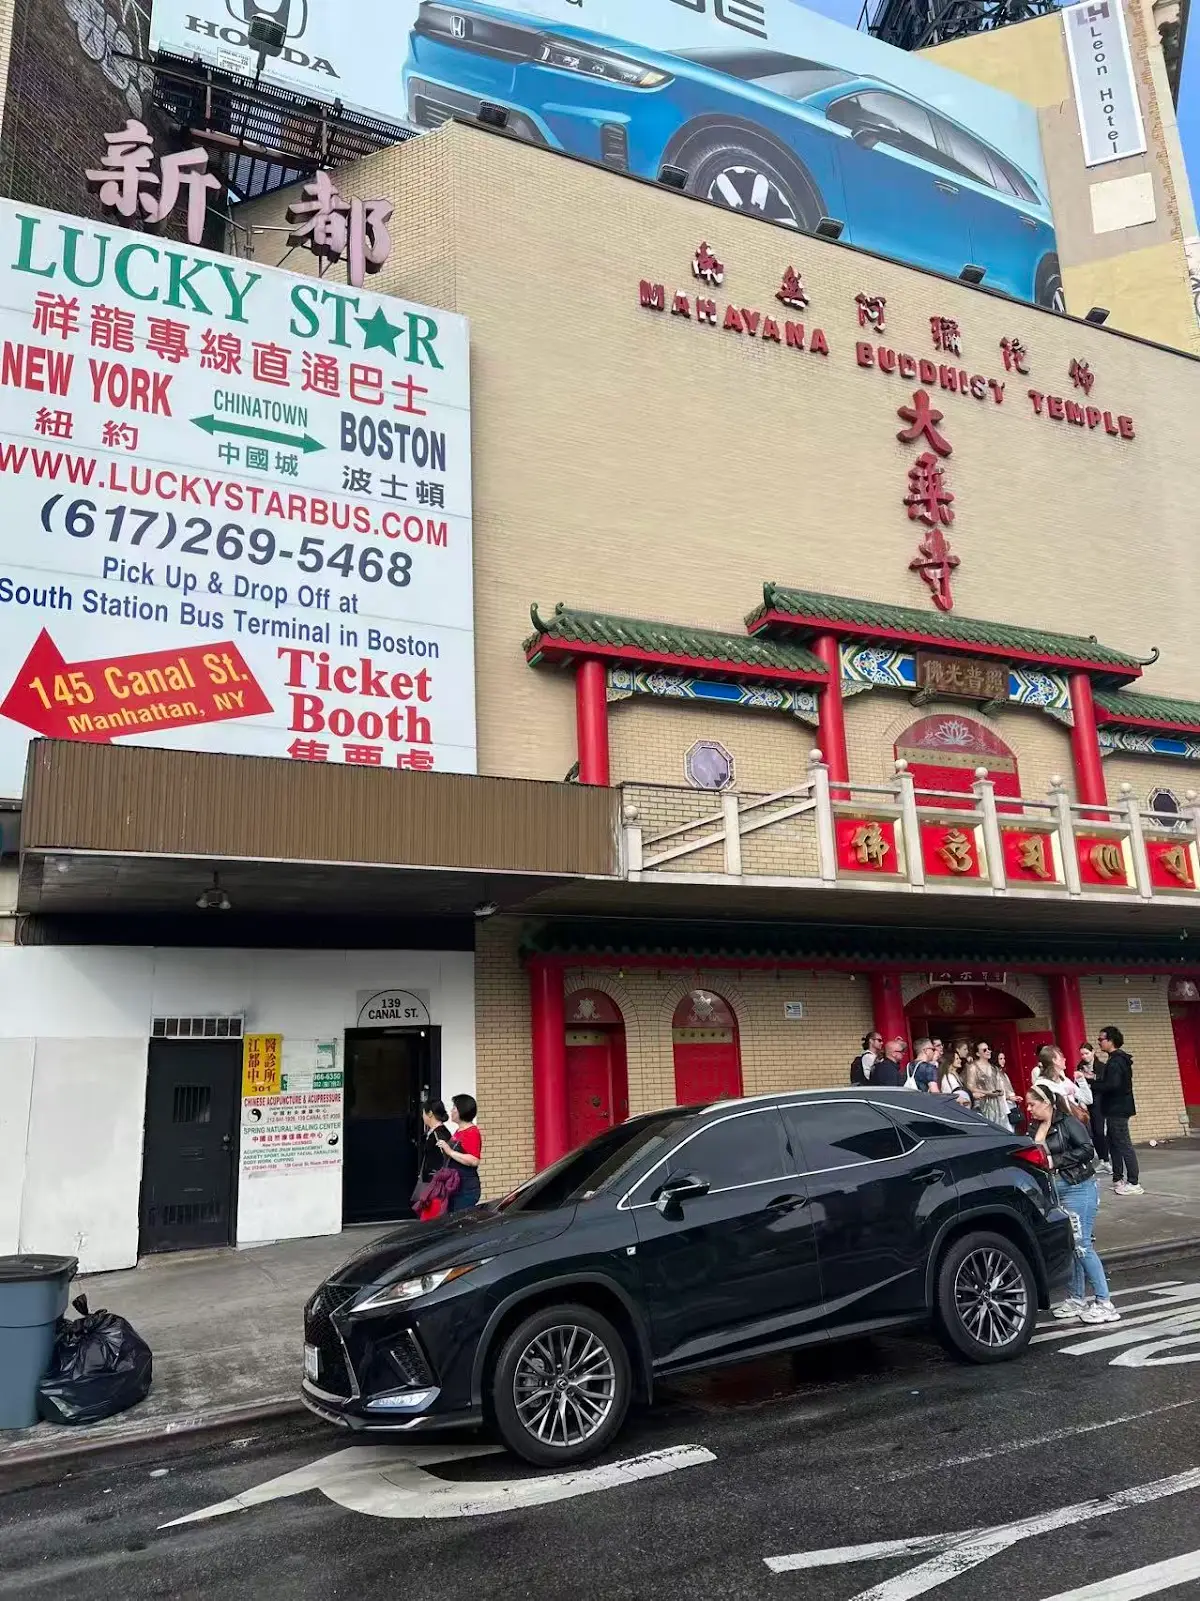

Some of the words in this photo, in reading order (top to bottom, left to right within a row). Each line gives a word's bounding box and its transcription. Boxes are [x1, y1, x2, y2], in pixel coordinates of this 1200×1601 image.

[184, 14, 341, 79] HODA
[1090, 26, 1108, 76] Leon
[1100, 88, 1119, 153] Hotel
[86, 119, 392, 286] 新都
[11, 213, 262, 324] LUCKY
[2, 341, 74, 397] NEW
[89, 358, 173, 417] YORK
[32, 291, 429, 416] 祥龍專線直通巴士
[640, 279, 829, 356] MAHAYANA
[856, 341, 1005, 403] BUDDHIST
[1028, 389, 1136, 440] TEMPLE
[34, 407, 139, 451] 紐約
[213, 389, 308, 428] CHINATOWN
[218, 442, 299, 477] 中國城
[340, 411, 446, 472] BOSTON
[0, 442, 448, 547] WWW.LUCKYSTARBUS.COM
[342, 464, 446, 509] 波士頓
[40, 494, 413, 587] (617)269-5468
[103, 556, 155, 585] Pick
[165, 565, 198, 595] Up
[207, 572, 224, 594] &
[234, 575, 288, 608] Drop
[298, 584, 330, 609] Off
[339, 593, 358, 614] at
[0, 578, 73, 611] South
[82, 589, 168, 622] Station
[180, 604, 224, 629] Bus
[233, 609, 330, 645] Terminal
[340, 625, 358, 647] in
[368, 628, 439, 658] Boston
[29, 671, 95, 709] 145
[103, 658, 195, 699] Canal
[203, 652, 249, 684] St.
[278, 647, 432, 702] Ticket
[67, 699, 206, 733] Manhattan,
[214, 690, 245, 710] NY
[287, 692, 433, 744] Booth
[368, 1009, 401, 1020] CANAL
[404, 1008, 418, 1018] ST.
[381, 998, 401, 1009] 139
[243, 1126, 266, 1135] SPRING
[266, 1125, 292, 1133] NATURAL
[293, 1123, 318, 1132] HEALING
[319, 1122, 341, 1130] CENTER
[244, 1096, 266, 1107] CHINESE
[266, 1095, 302, 1106] ACUPUNCTURE
[308, 1093, 341, 1104] ACUPRESSURE
